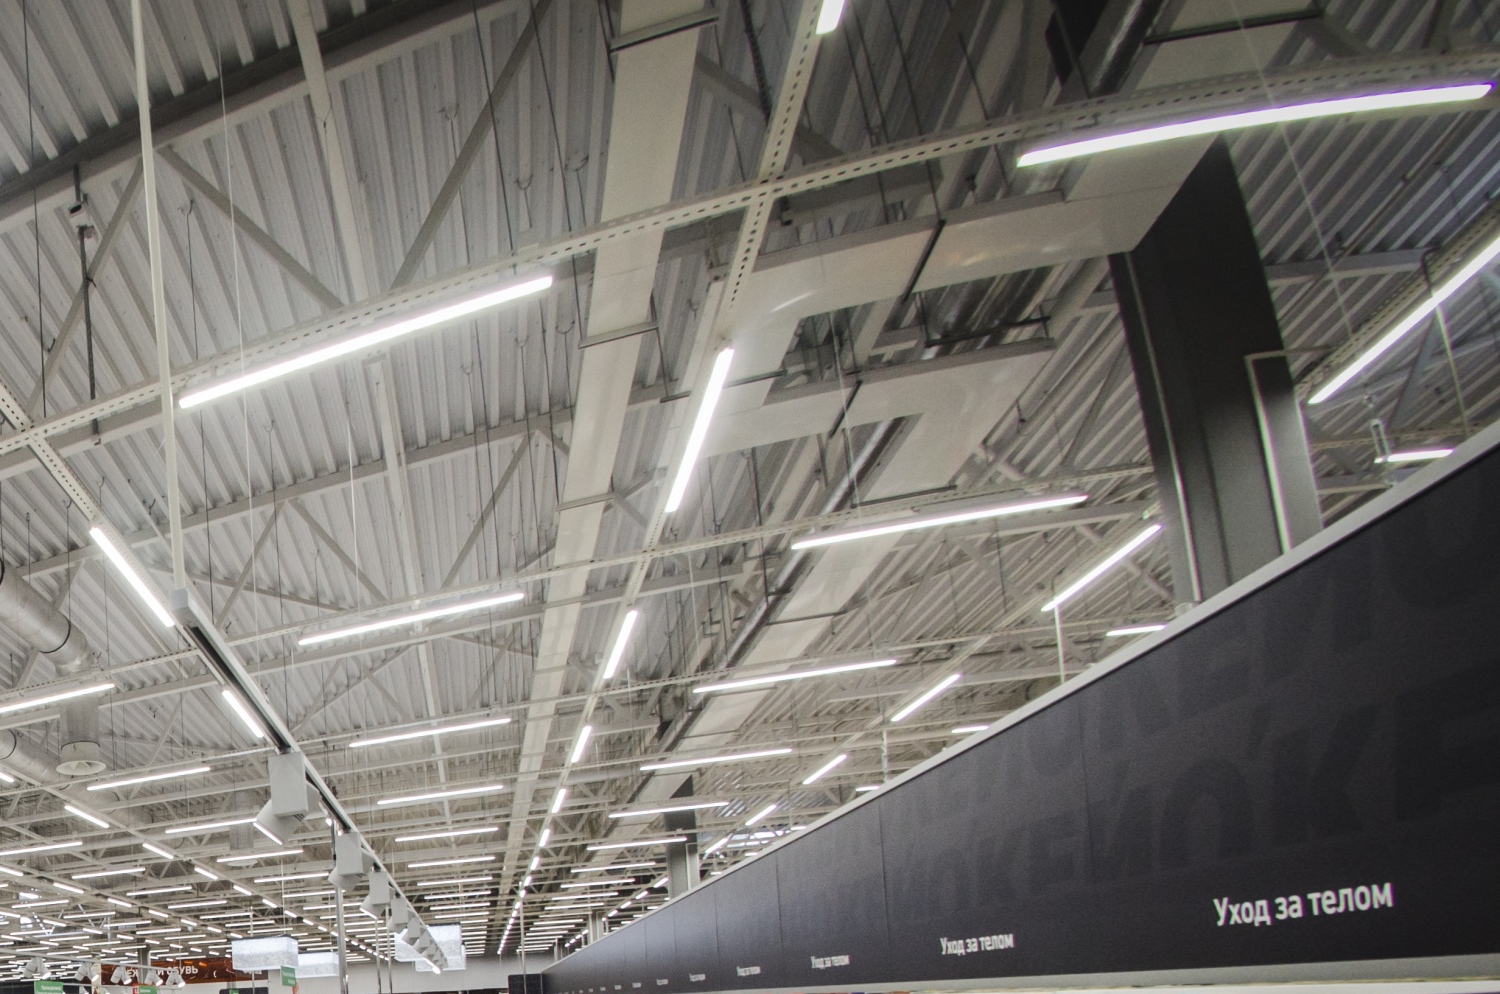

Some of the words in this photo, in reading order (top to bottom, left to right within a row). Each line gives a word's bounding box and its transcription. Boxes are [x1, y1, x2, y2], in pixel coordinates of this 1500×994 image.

[1213, 897, 1272, 927] Уход
[1275, 894, 1304, 920] за
[1307, 882, 1394, 916] телом
[940, 937, 966, 956] Уход
[966, 938, 978, 953] за
[979, 933, 1015, 951] телом
[167, 965, 199, 976] ОУВЬ
